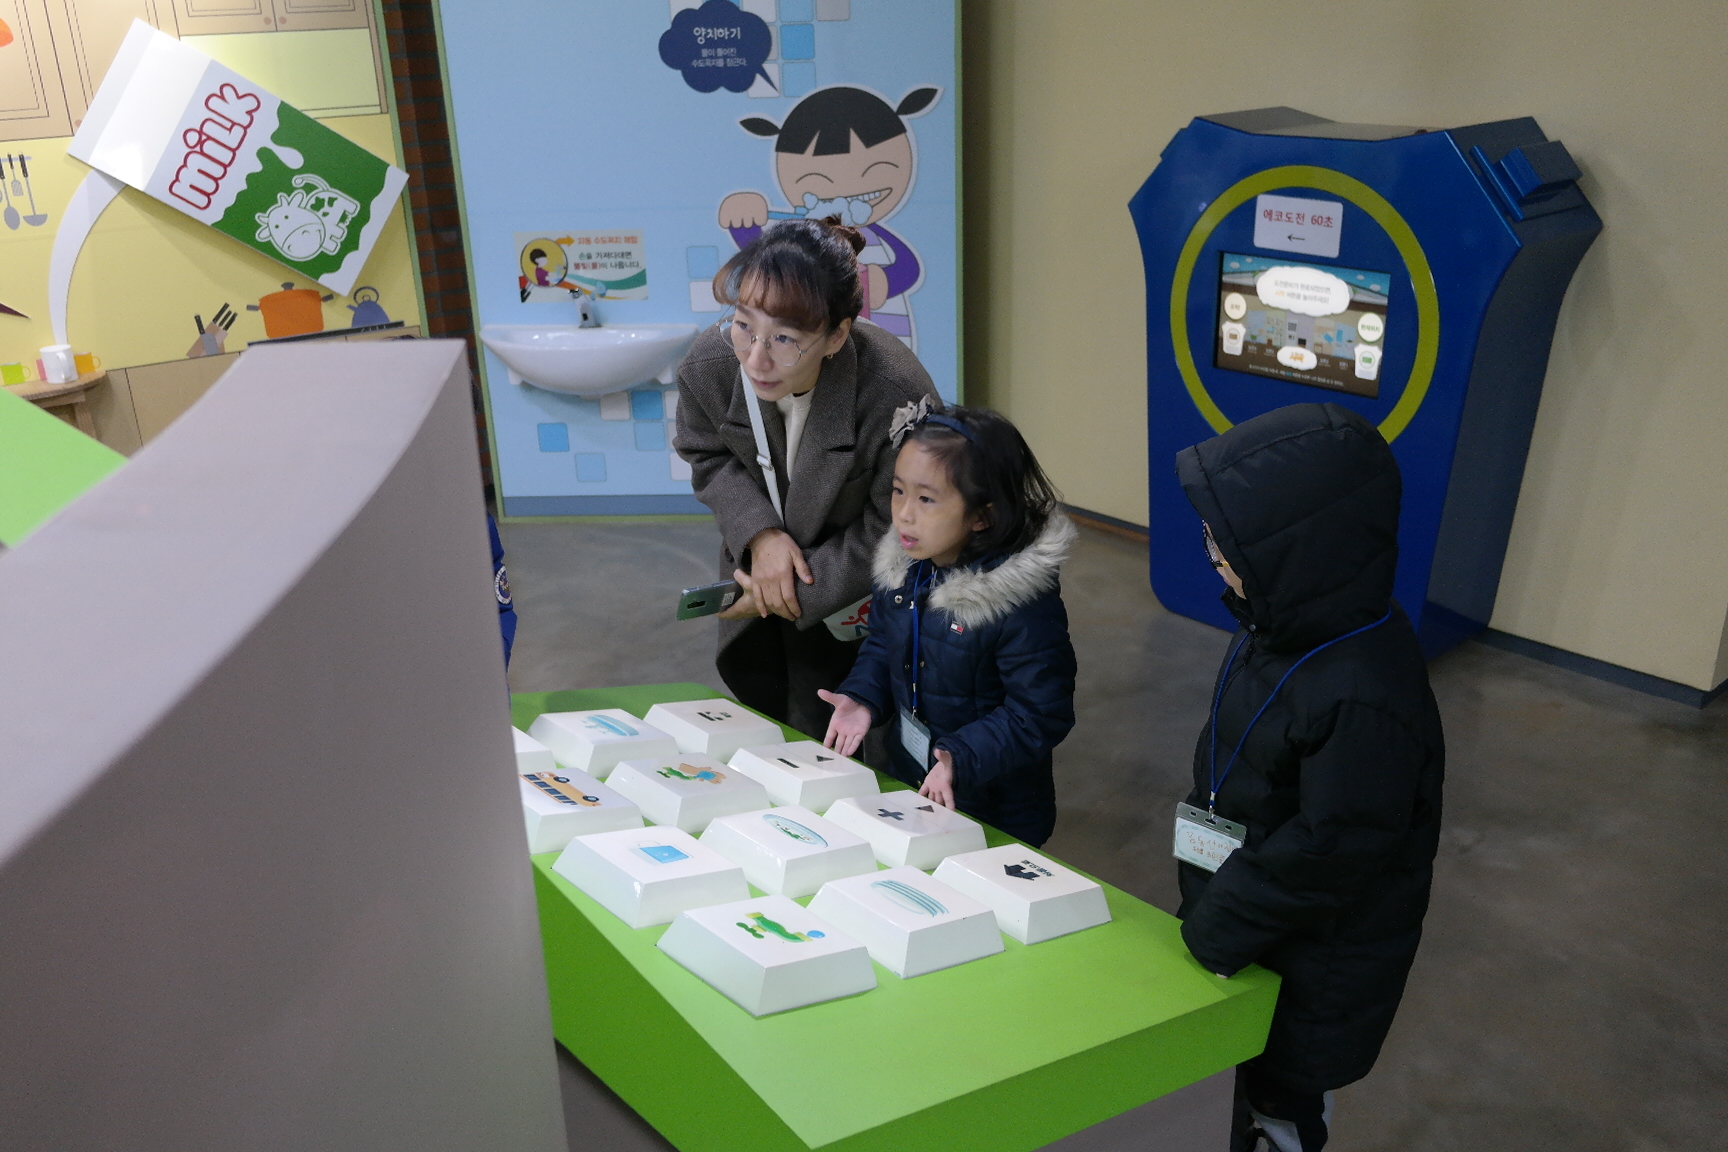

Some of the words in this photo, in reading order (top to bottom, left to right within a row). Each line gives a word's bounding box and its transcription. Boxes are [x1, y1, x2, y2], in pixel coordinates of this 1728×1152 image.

[693, 27, 741, 45] 양치하기
[1263, 209, 1305, 226] 에코도전
[1310, 214, 1334, 229] 60초
[594, 236, 621, 244] 수도꼭지
[579, 252, 592, 260] 손을
